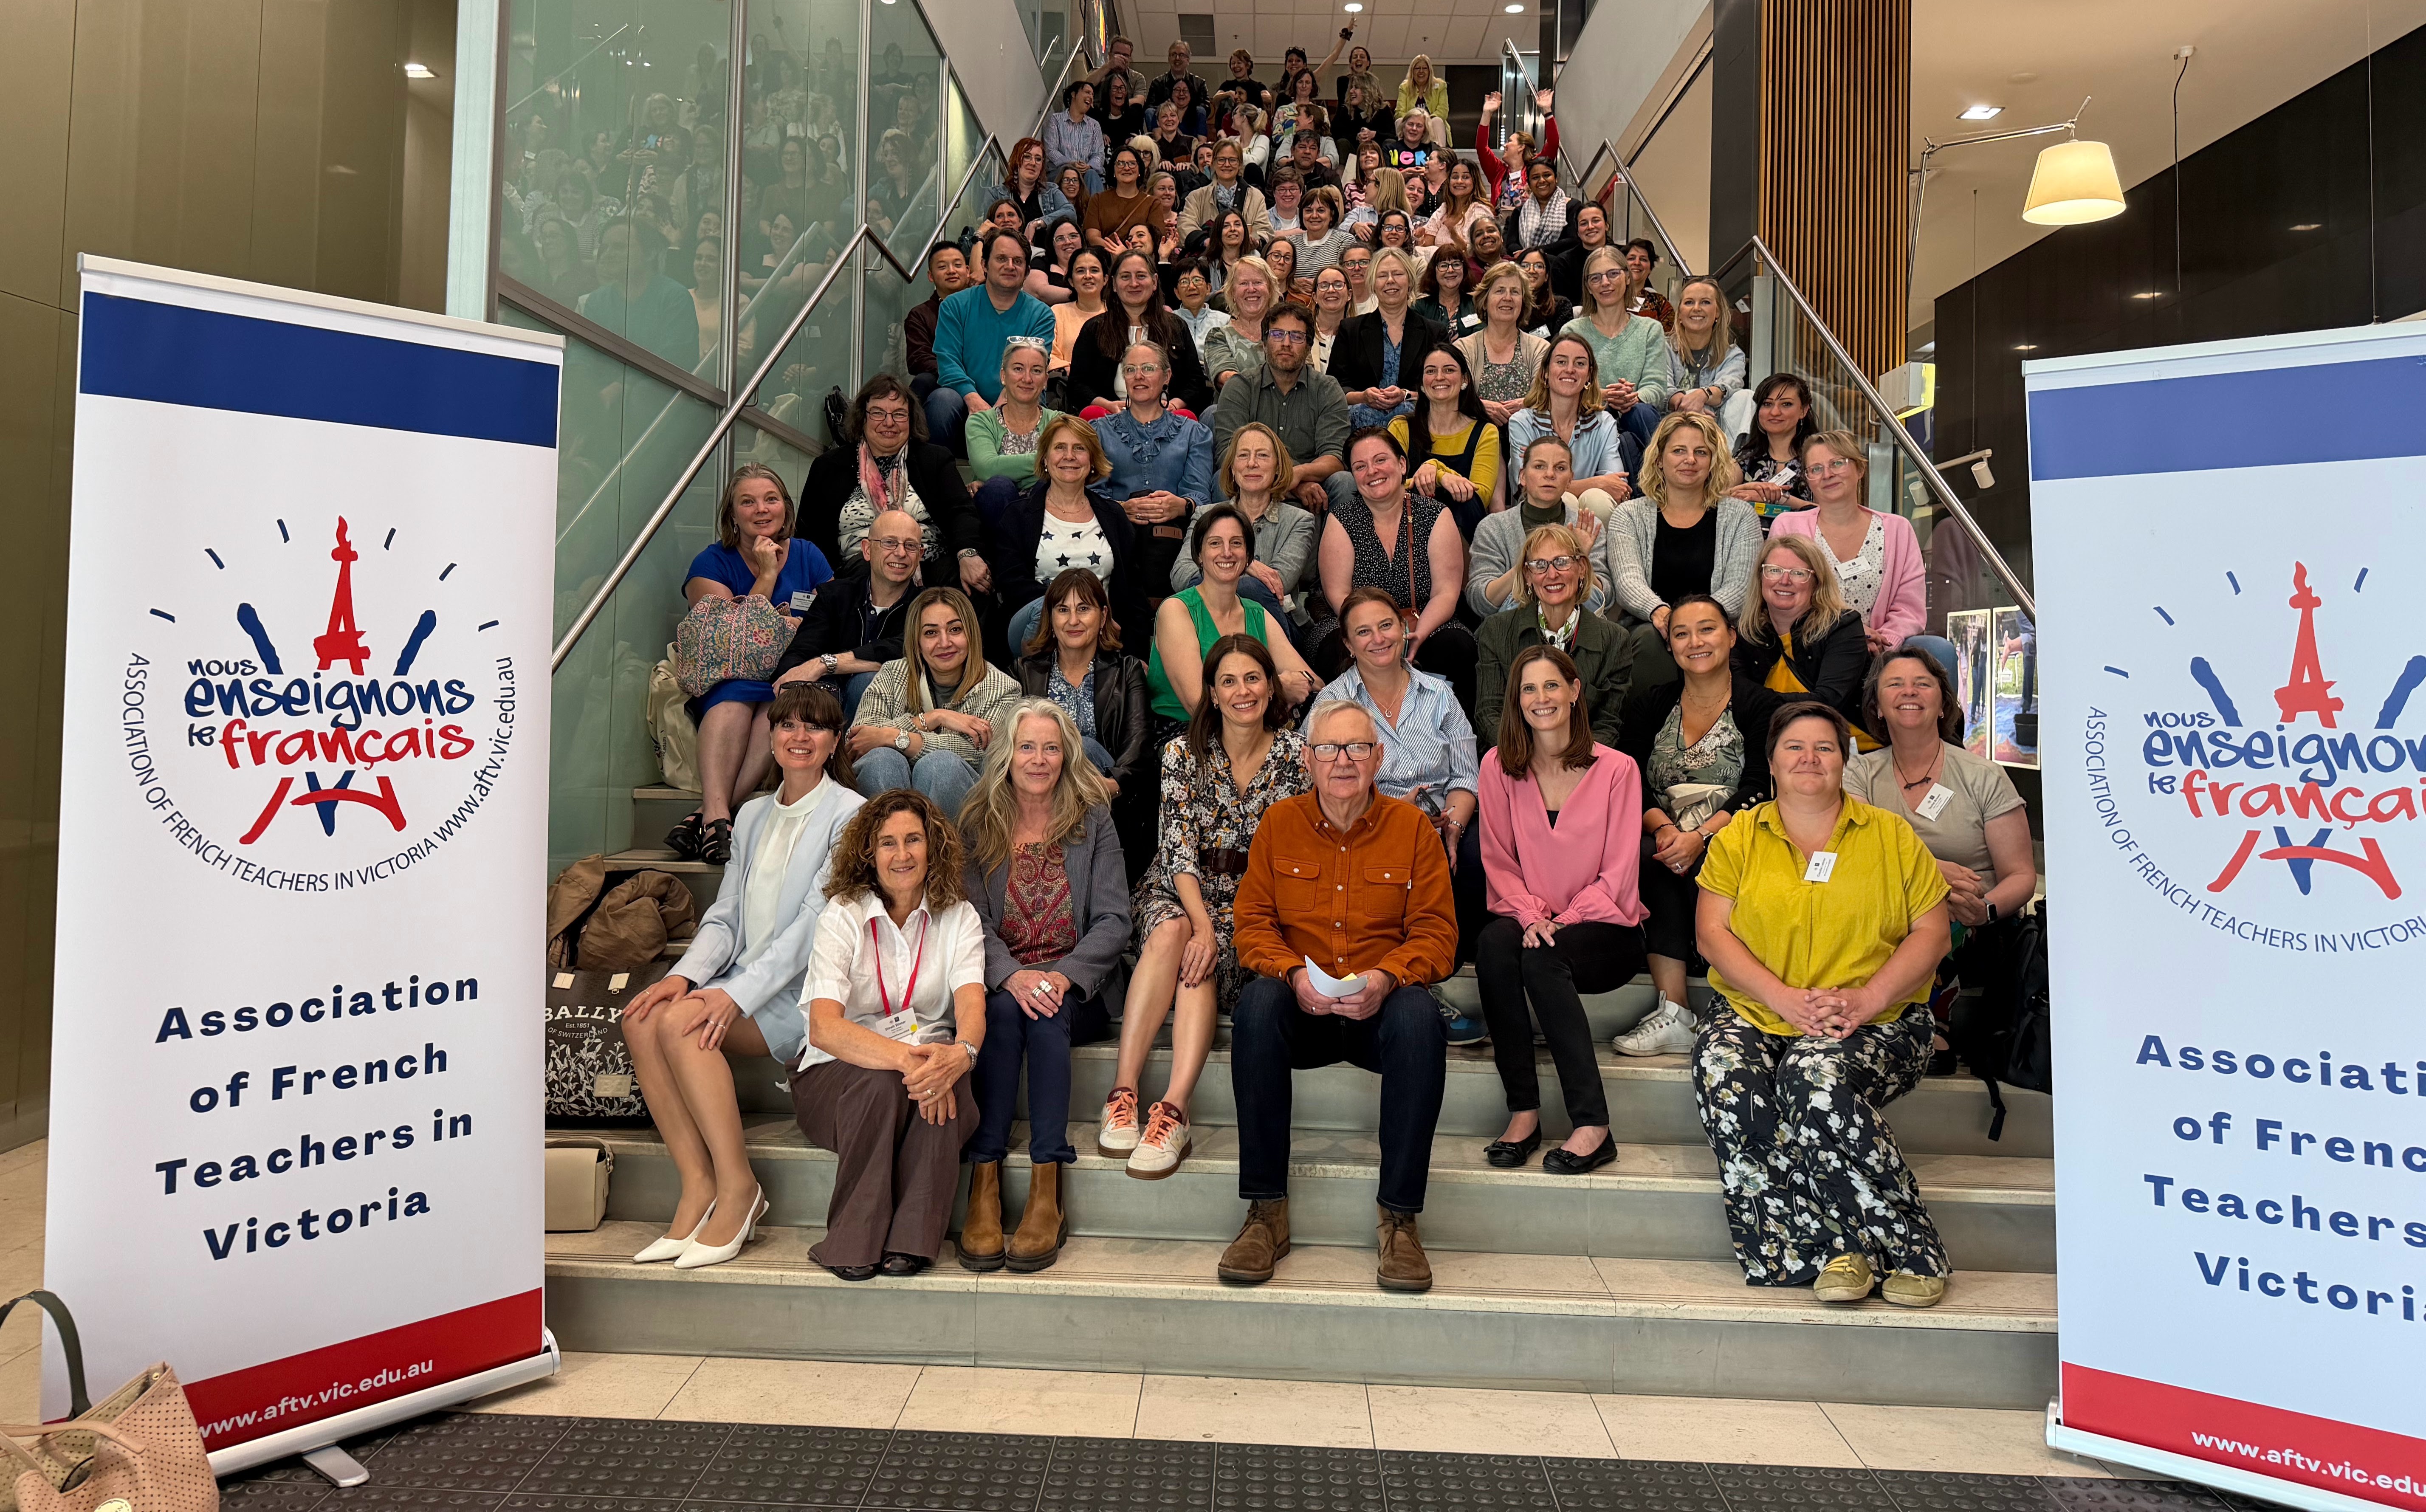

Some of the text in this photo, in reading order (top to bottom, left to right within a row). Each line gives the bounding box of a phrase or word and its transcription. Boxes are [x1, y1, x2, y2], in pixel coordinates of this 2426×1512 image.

[184, 671, 475, 732] enseignons
[187, 659, 258, 677] nous
[218, 718, 474, 770] français
[2143, 711, 2215, 728] nous
[123, 652, 516, 891] ASSOCIATION OF FRENCH TEACHERS IN VICTORIA www.aftv.vic.edu.au
[2085, 706, 2122, 827] ASSOCIATION
[2112, 829, 2138, 851] OF
[2129, 852, 2200, 914] FRENCH
[2201, 903, 2307, 951] TEACHERS
[2315, 934, 2337, 952] IN
[155, 975, 478, 1044] Association
[557, 1028, 608, 1038] SWITZERLAND
[190, 1042, 447, 1113] of French
[155, 1109, 471, 1195] Teachers in
[2173, 1111, 2232, 1145] of
[203, 1187, 431, 1261] Victoria
[2144, 1174, 2426, 1248] Teachers
[2194, 1251, 2426, 1322] Victori
